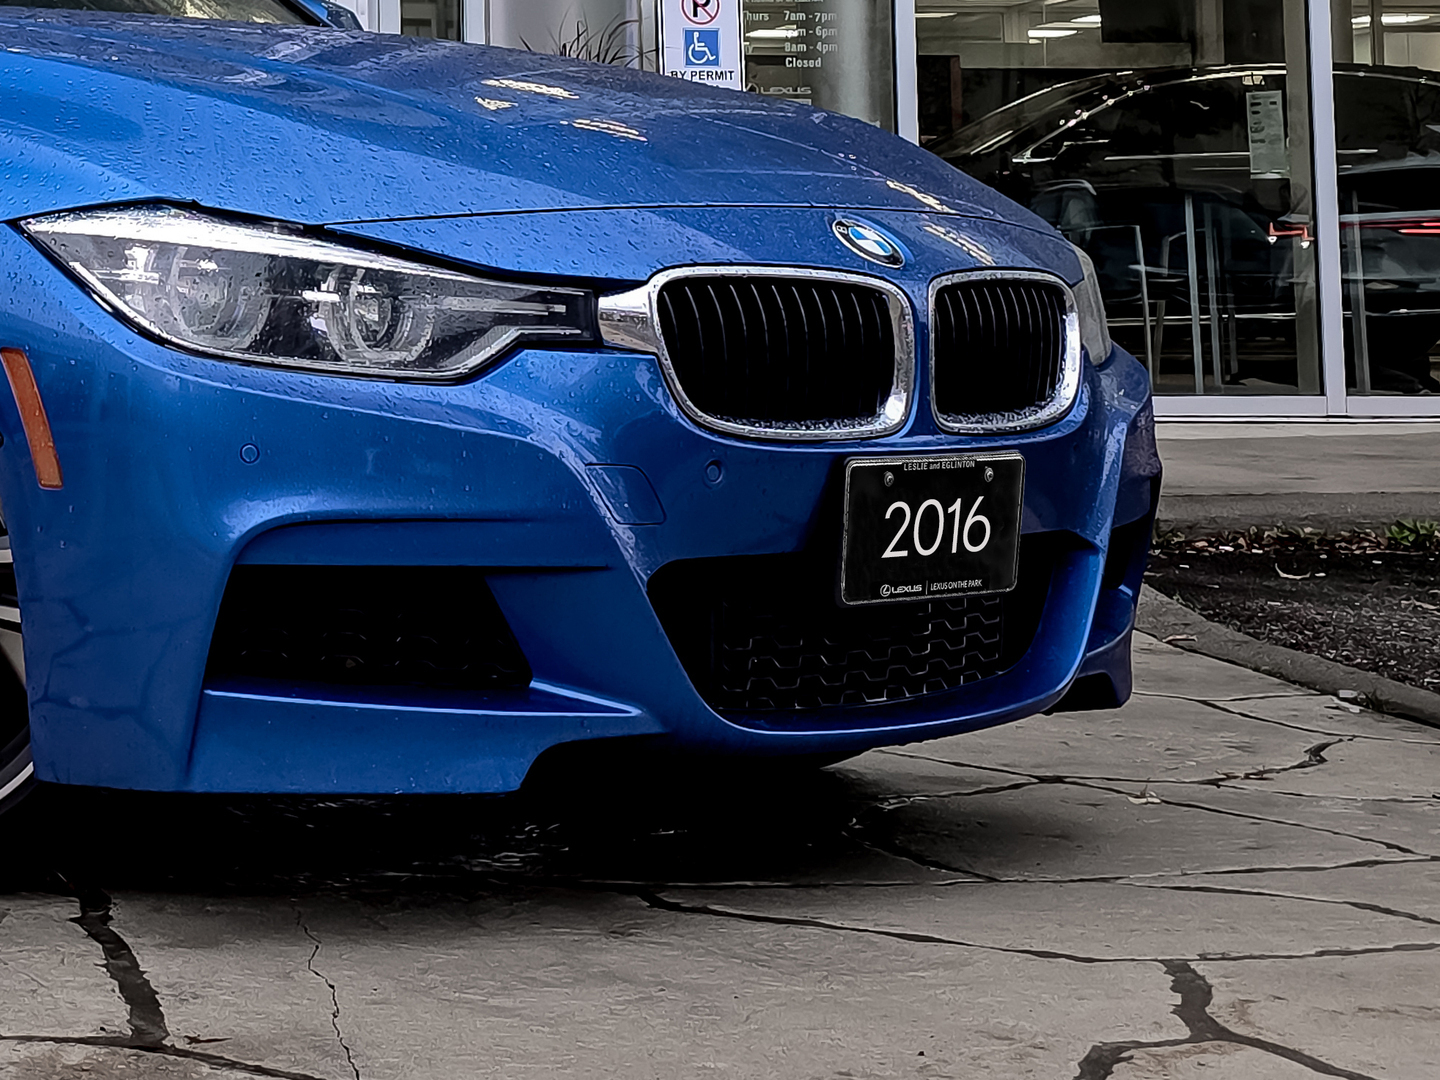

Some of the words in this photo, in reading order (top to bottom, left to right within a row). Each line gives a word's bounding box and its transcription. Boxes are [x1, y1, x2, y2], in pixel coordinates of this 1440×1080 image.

[784, 10, 806, 21] 7am
[814, 12, 838, 23] 7pm
[815, 26, 838, 39] 6pm
[784, 42, 807, 52] 8am
[816, 41, 838, 54] 4pm
[785, 57, 822, 68] Closed
[670, 70, 687, 80] BY
[691, 70, 735, 81] PERMIT
[761, 86, 812, 95] LEXUS
[903, 462, 928, 471] LESLIE
[929, 462, 940, 470] and
[941, 460, 975, 470] EGLINTON
[881, 496, 991, 558] 2016
[891, 584, 922, 594] LEXUS
[930, 582, 948, 591] LEXUS
[948, 581, 958, 589] ON
[958, 580, 967, 589] THE
[968, 579, 983, 588] PARK
